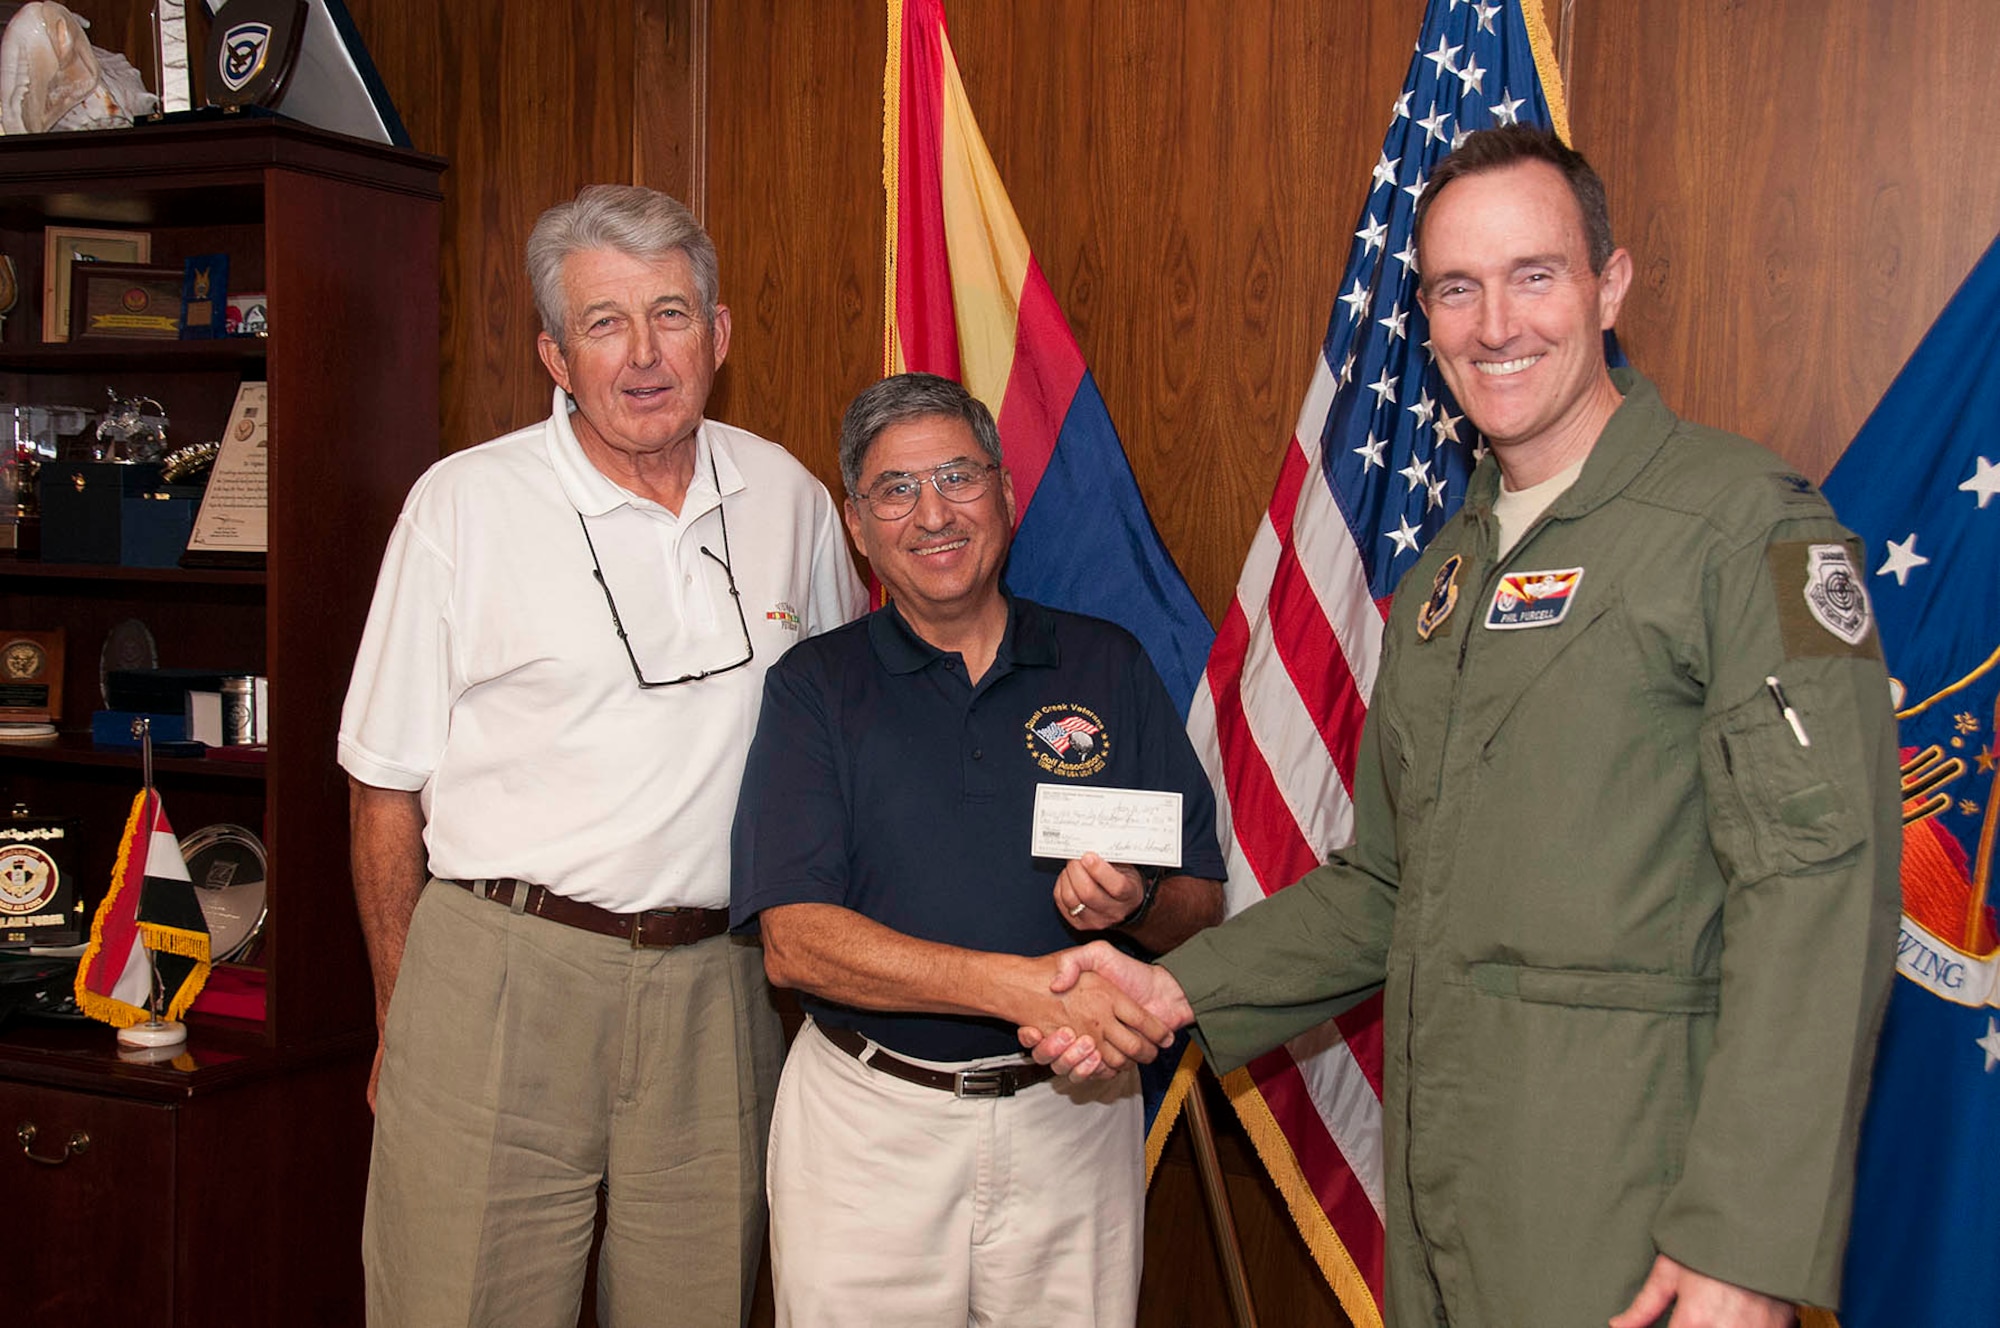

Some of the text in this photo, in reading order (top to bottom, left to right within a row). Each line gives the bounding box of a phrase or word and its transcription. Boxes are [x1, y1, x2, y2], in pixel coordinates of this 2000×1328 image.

[1519, 609, 1554, 621] PURCELL
[1024, 703, 1104, 730] Quail Creek Veterans
[1040, 753, 1101, 771] Golf Association
[1066, 770, 1079, 778] USA
[27, 914, 65, 926] FORCE
